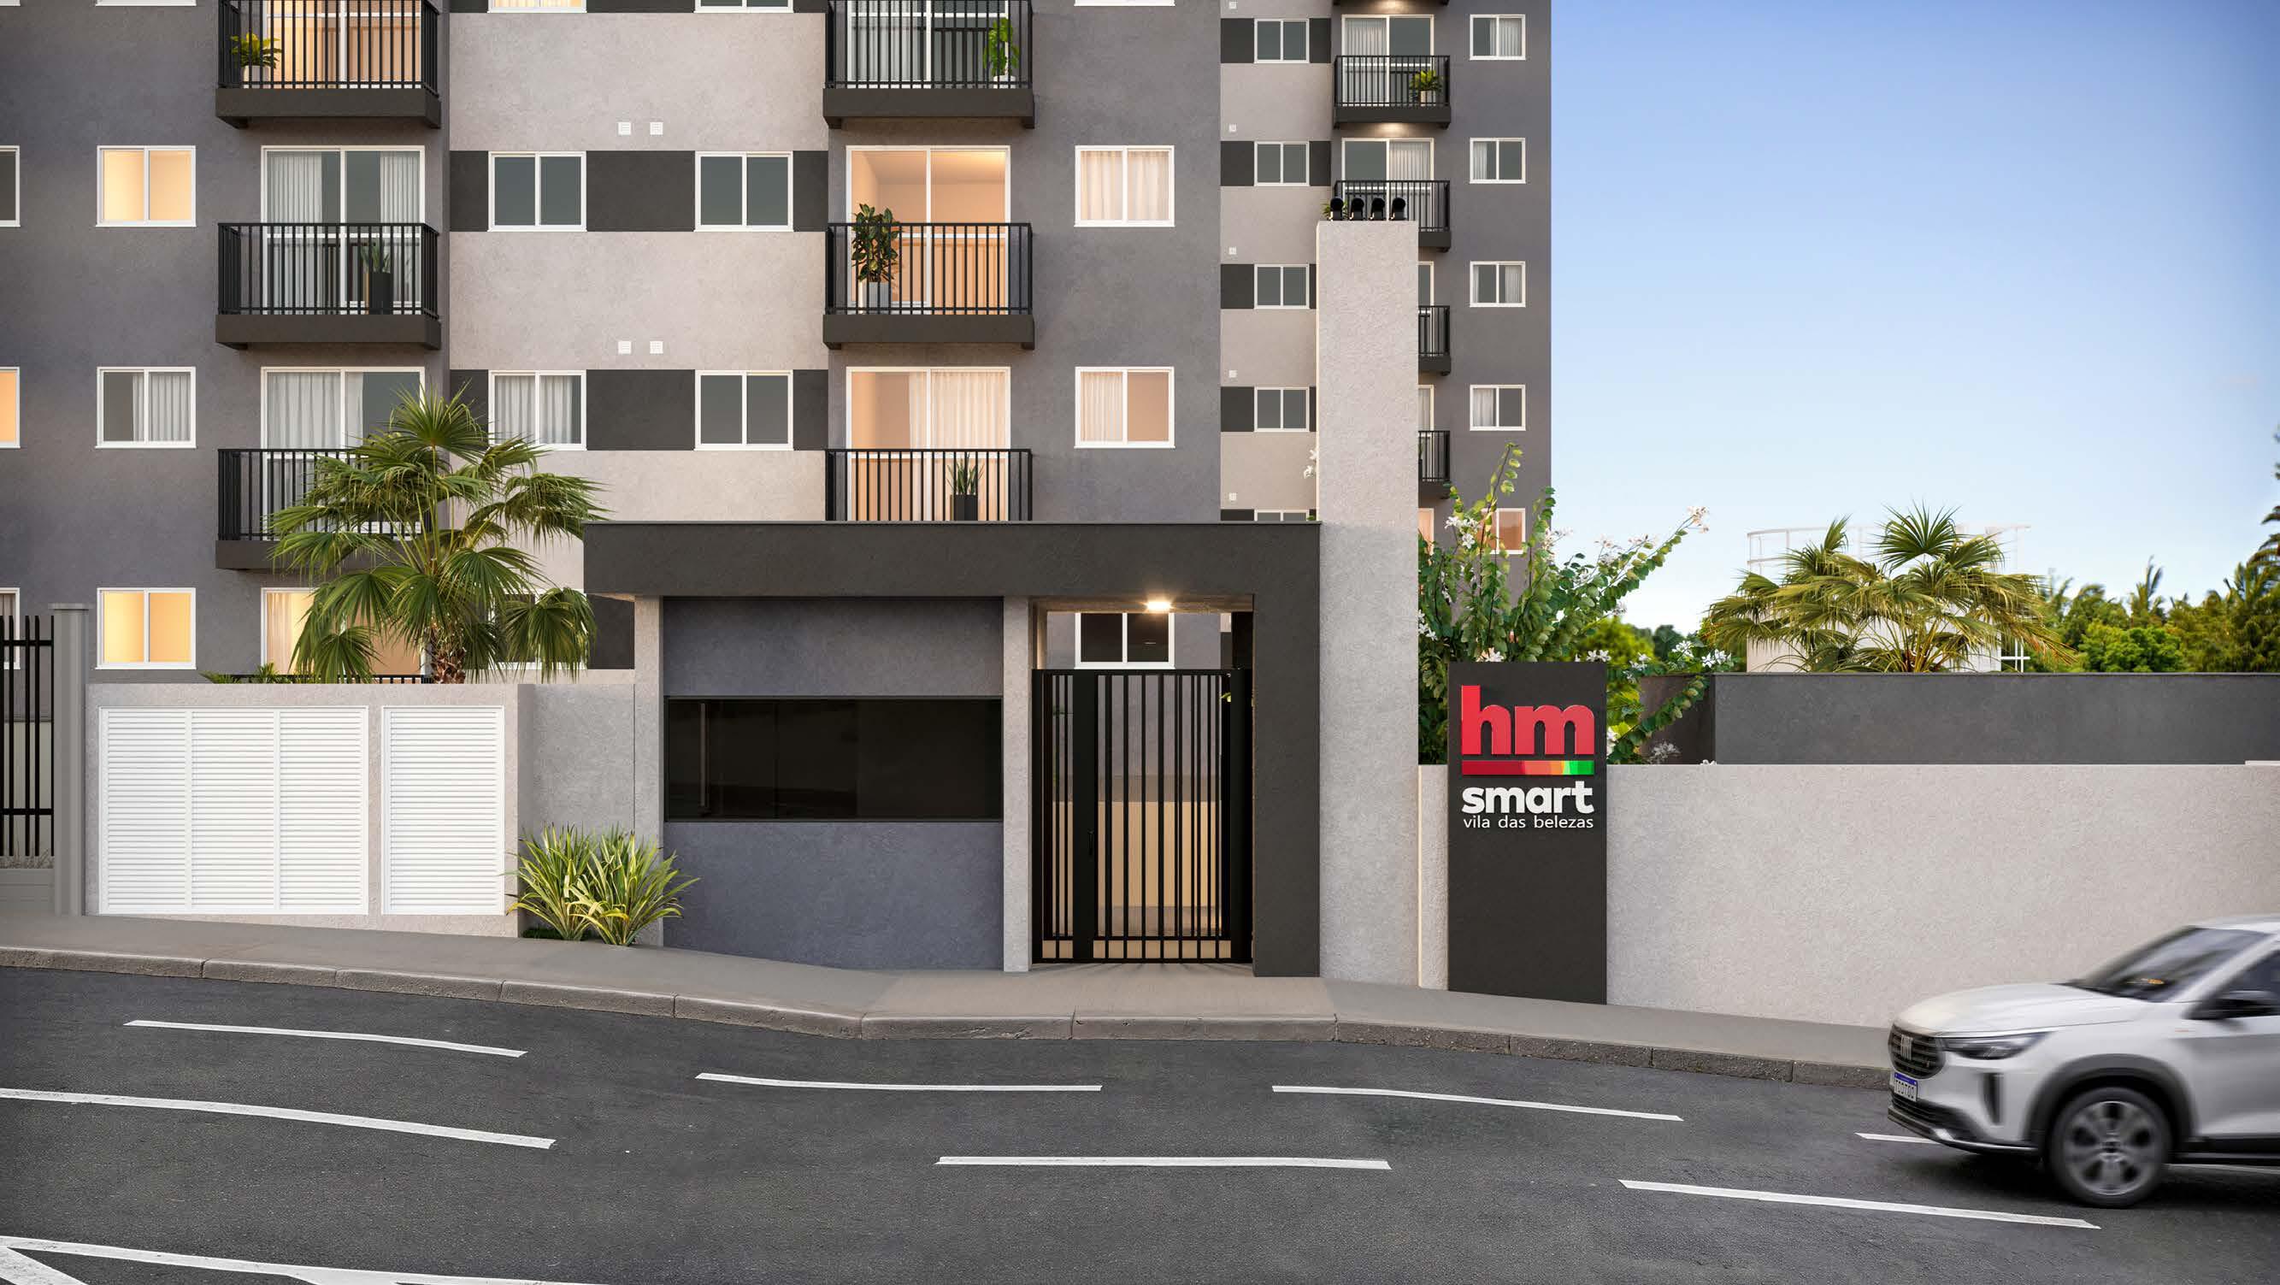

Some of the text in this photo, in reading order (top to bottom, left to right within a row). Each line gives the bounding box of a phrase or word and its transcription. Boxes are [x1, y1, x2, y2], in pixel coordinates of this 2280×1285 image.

[1461, 685, 1595, 755] hm
[1461, 780, 1595, 814] smart
[1463, 815, 1594, 829] vila das belezas
